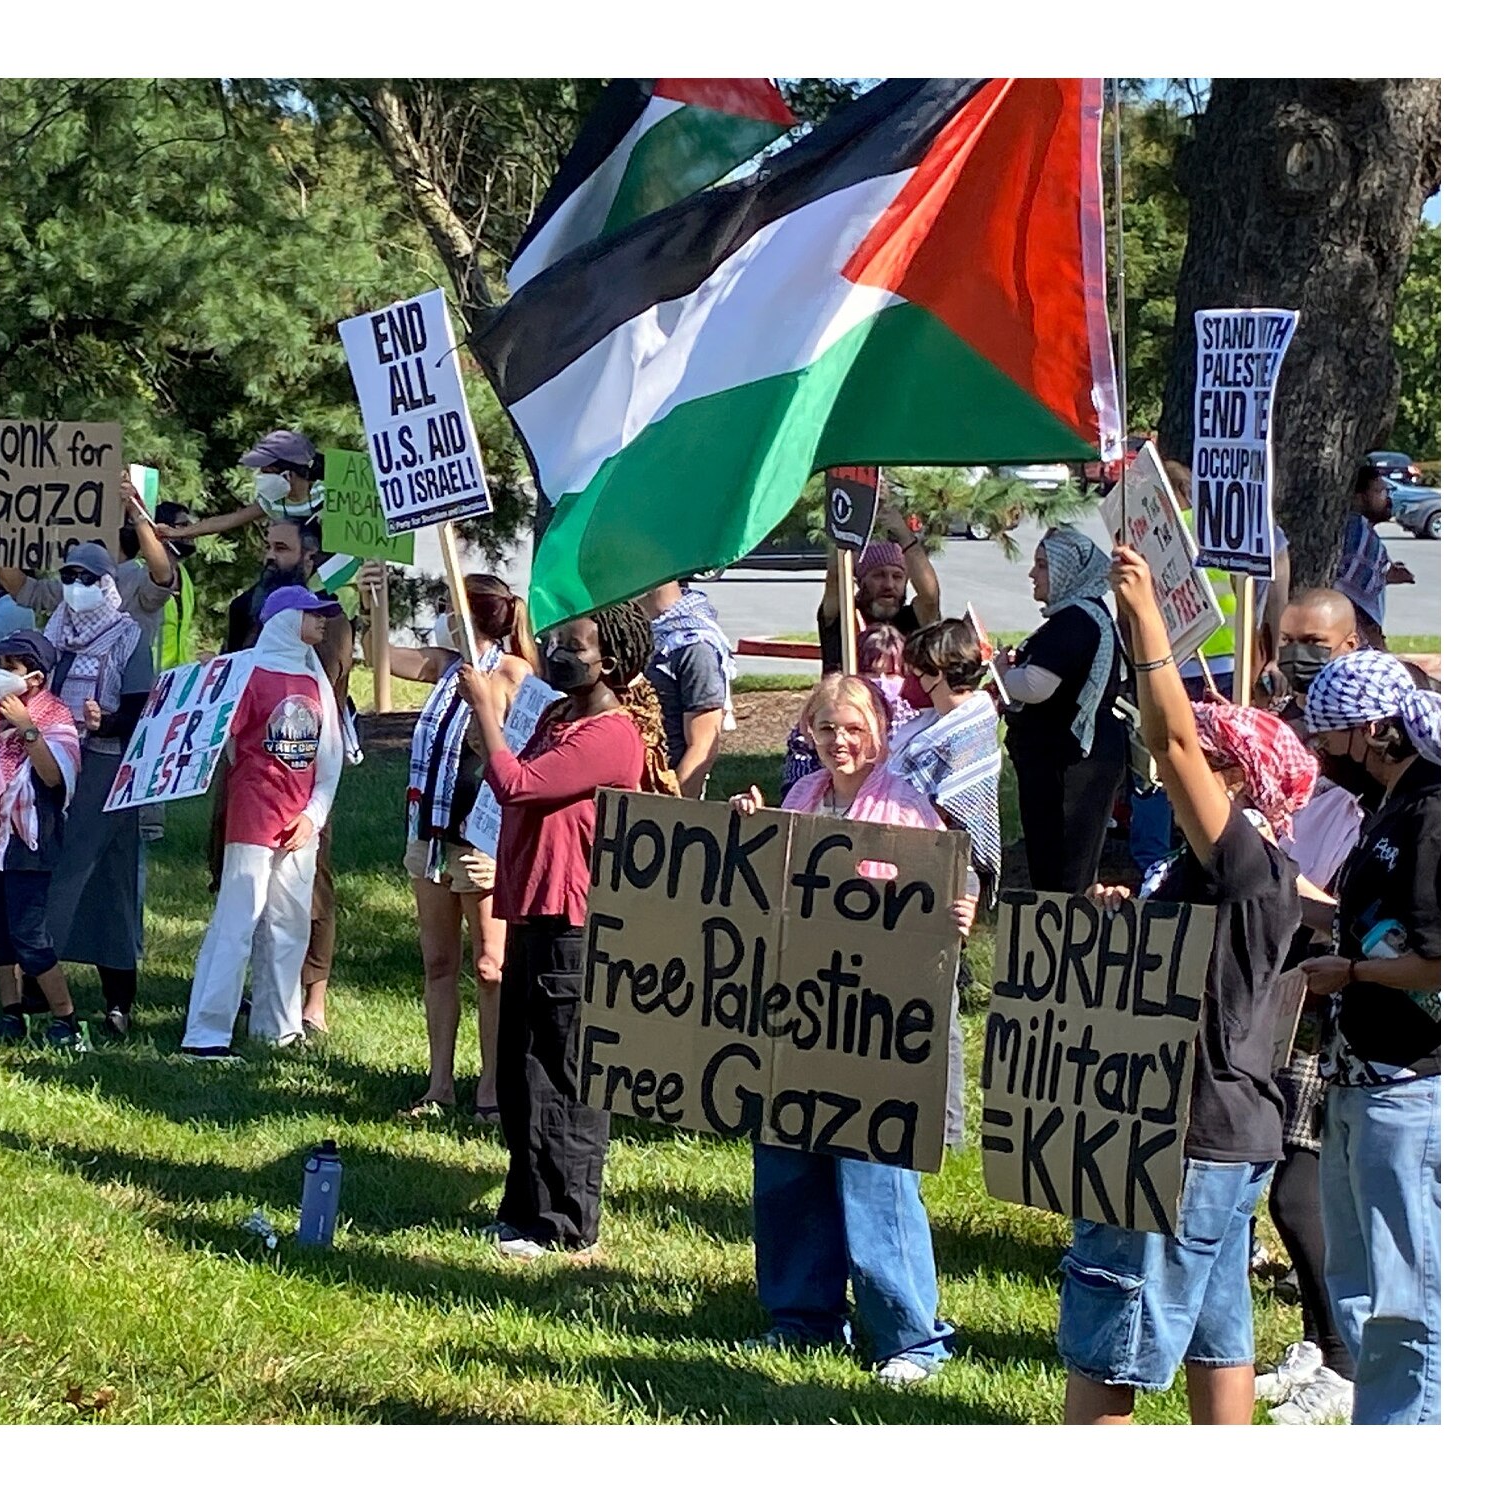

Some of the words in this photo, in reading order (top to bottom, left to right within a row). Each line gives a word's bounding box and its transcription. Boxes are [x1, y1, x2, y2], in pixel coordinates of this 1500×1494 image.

[371, 302, 427, 365] END
[1202, 317, 1255, 350] STAND
[389, 357, 436, 416] ALL
[1199, 390, 1247, 439] END
[68, 430, 113, 467] for
[373, 424, 423, 475] U.S.
[427, 411, 466, 462] AID
[380, 476, 404, 512] TO
[407, 457, 478, 505] ISRAEL!
[127, 725, 148, 762] A
[590, 792, 780, 915] Honk
[791, 833, 936, 932] for
[993, 890, 1204, 1021] ISRAEL
[584, 913, 694, 1018] Free
[701, 917, 935, 1065] Palestine
[580, 1025, 685, 1124] Free
[701, 1042, 919, 1171] Gaza
